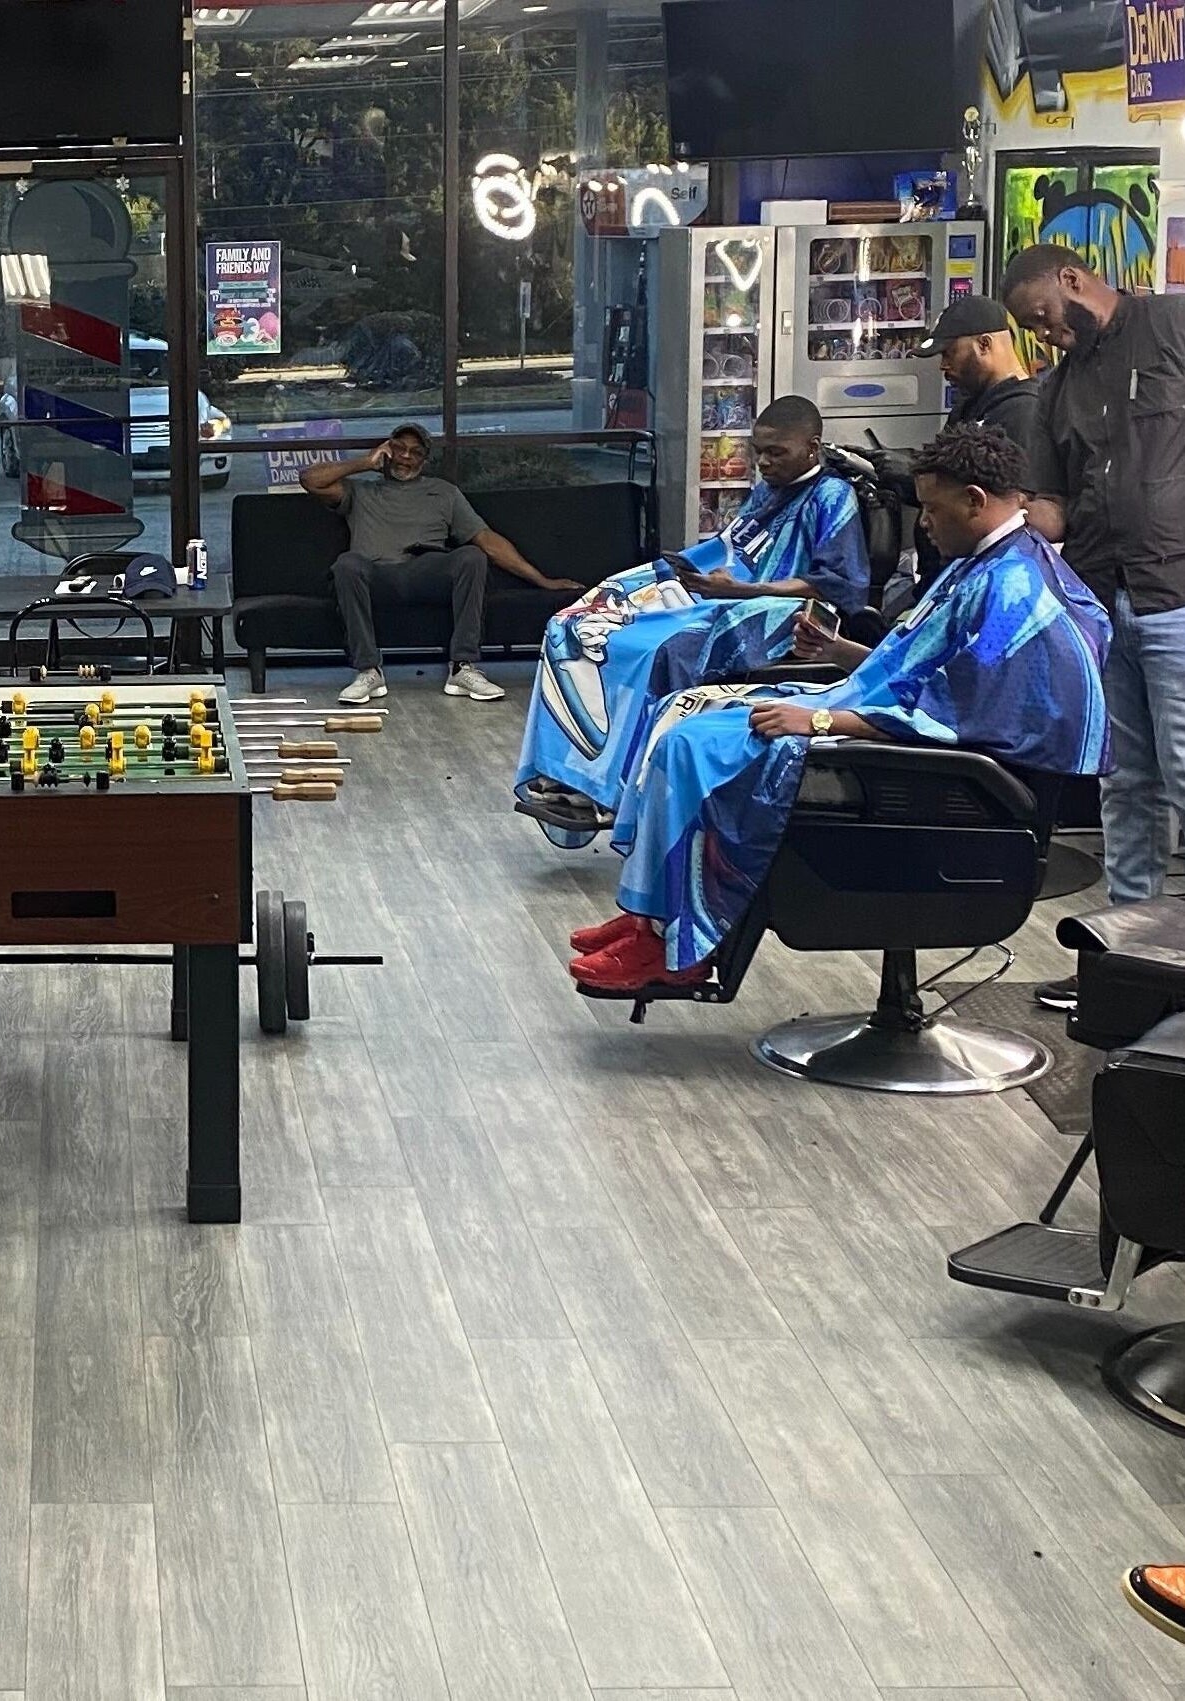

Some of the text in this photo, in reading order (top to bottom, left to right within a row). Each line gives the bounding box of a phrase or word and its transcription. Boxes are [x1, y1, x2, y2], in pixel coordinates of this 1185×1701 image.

[1130, 69, 1153, 98] DAVIS
[671, 186, 698, 201] Self
[216, 248, 271, 262] FAMILY AND
[216, 261, 271, 274] FRIENDS DAY
